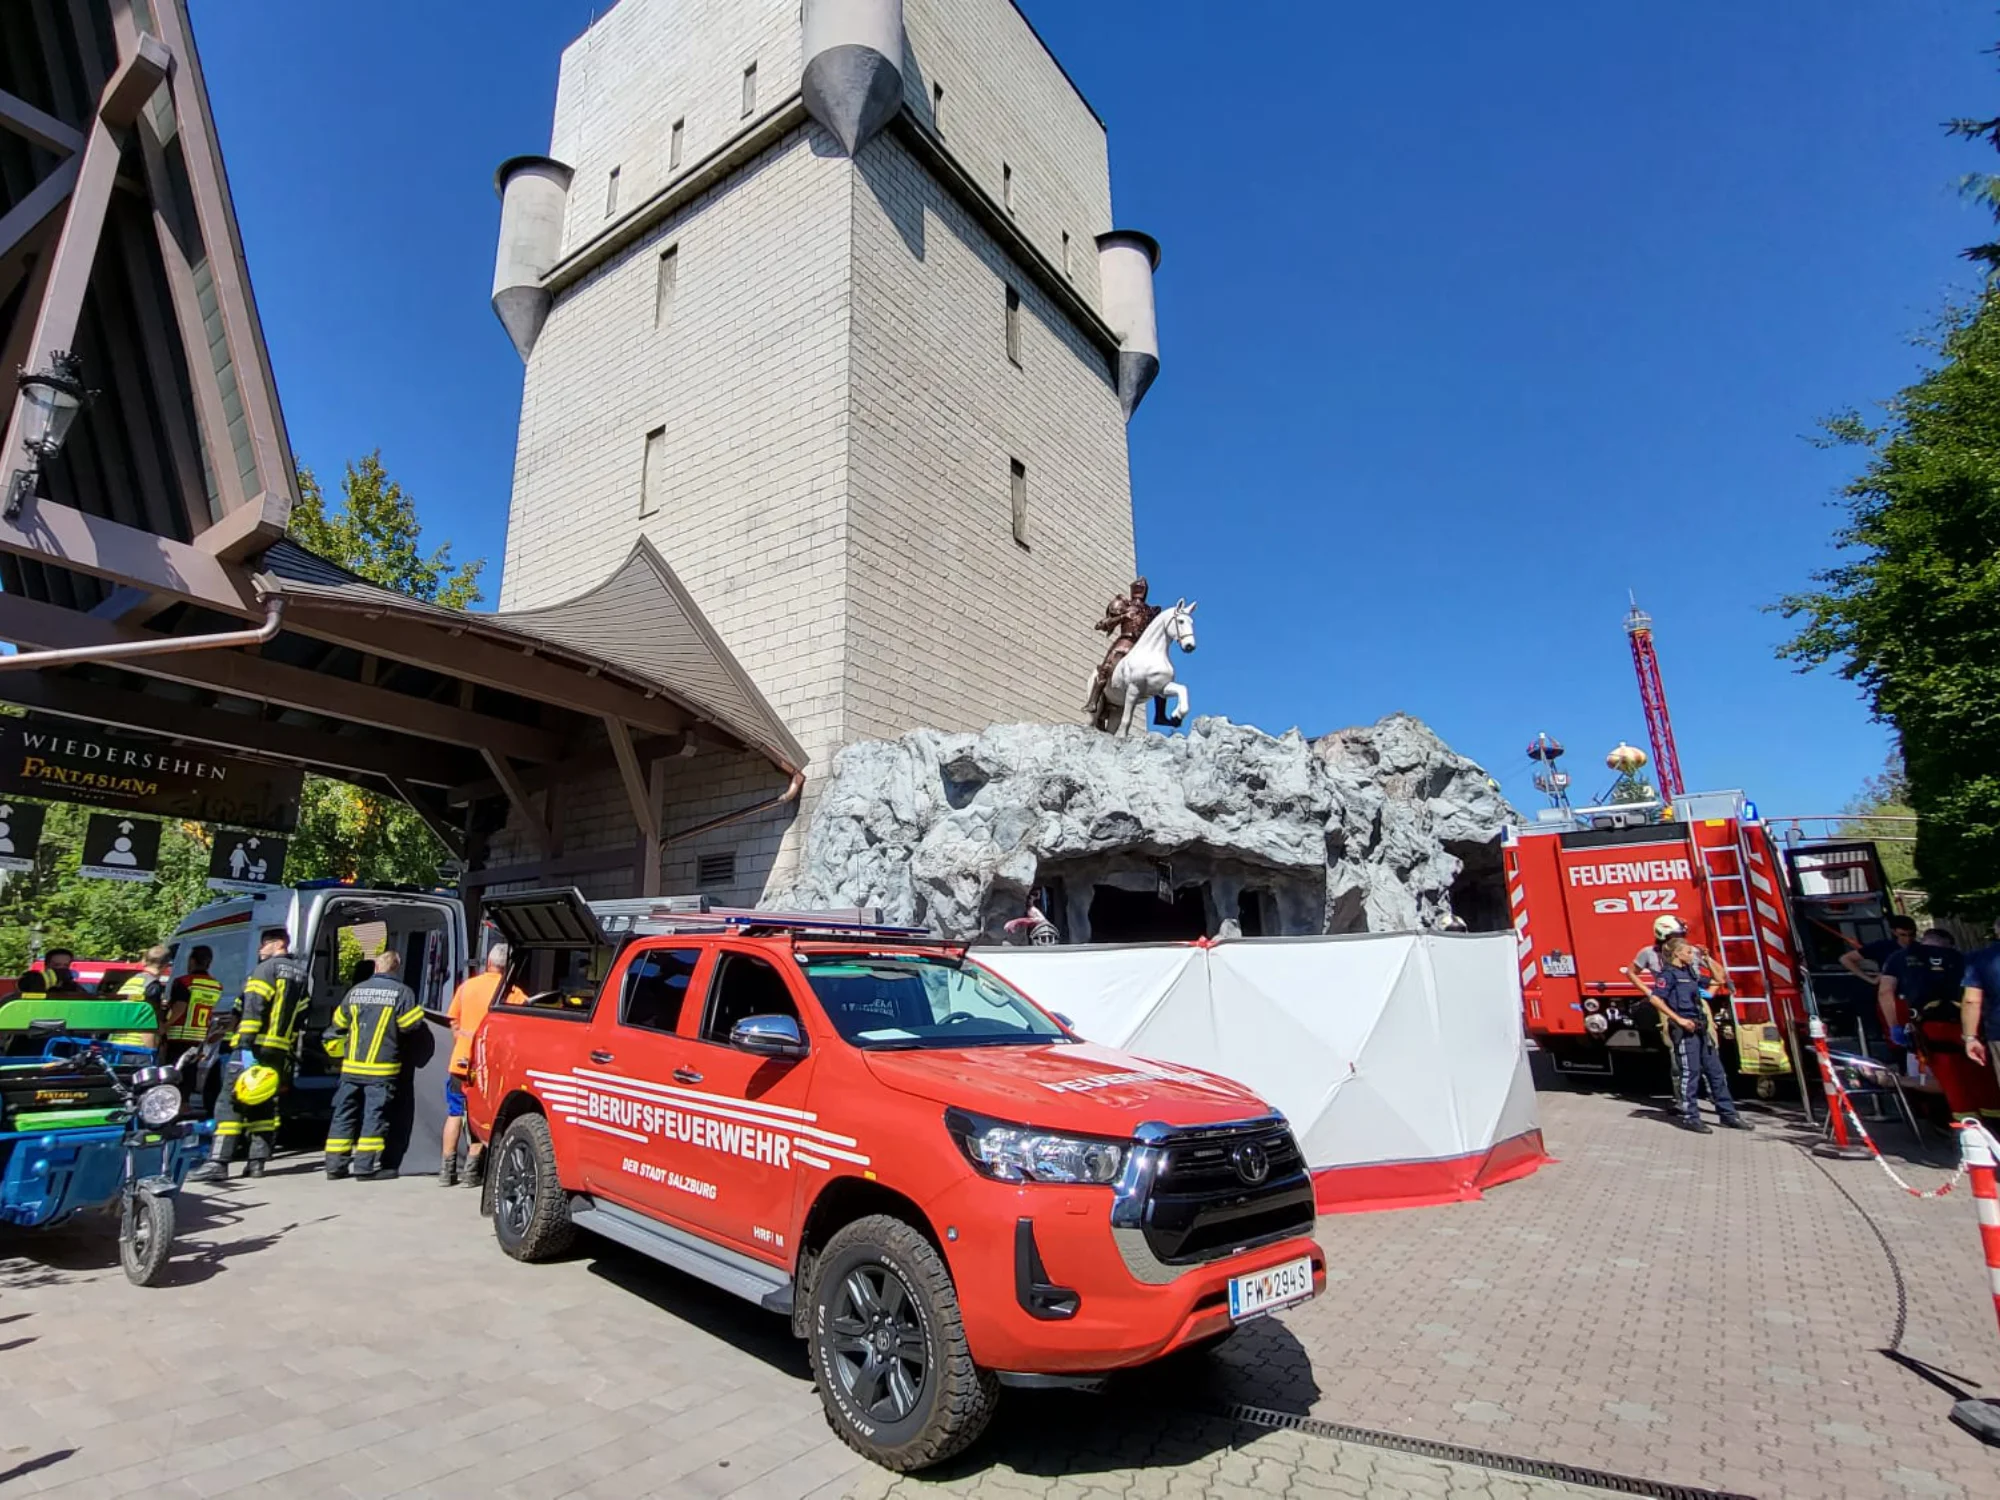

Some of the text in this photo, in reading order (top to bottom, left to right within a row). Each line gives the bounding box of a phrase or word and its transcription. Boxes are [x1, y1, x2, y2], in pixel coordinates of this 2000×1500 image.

[20, 756, 159, 796] FANTASIANA
[22, 731, 227, 781] WIEDERSEHEN
[1569, 859, 1692, 886] FEUERWEHR
[1629, 889, 1679, 912] 122
[588, 1092, 790, 1170] BERUFSFEUERWEHR
[622, 1157, 717, 1200] DER STADT SALZBURG
[1246, 1279, 1264, 1308] FW
